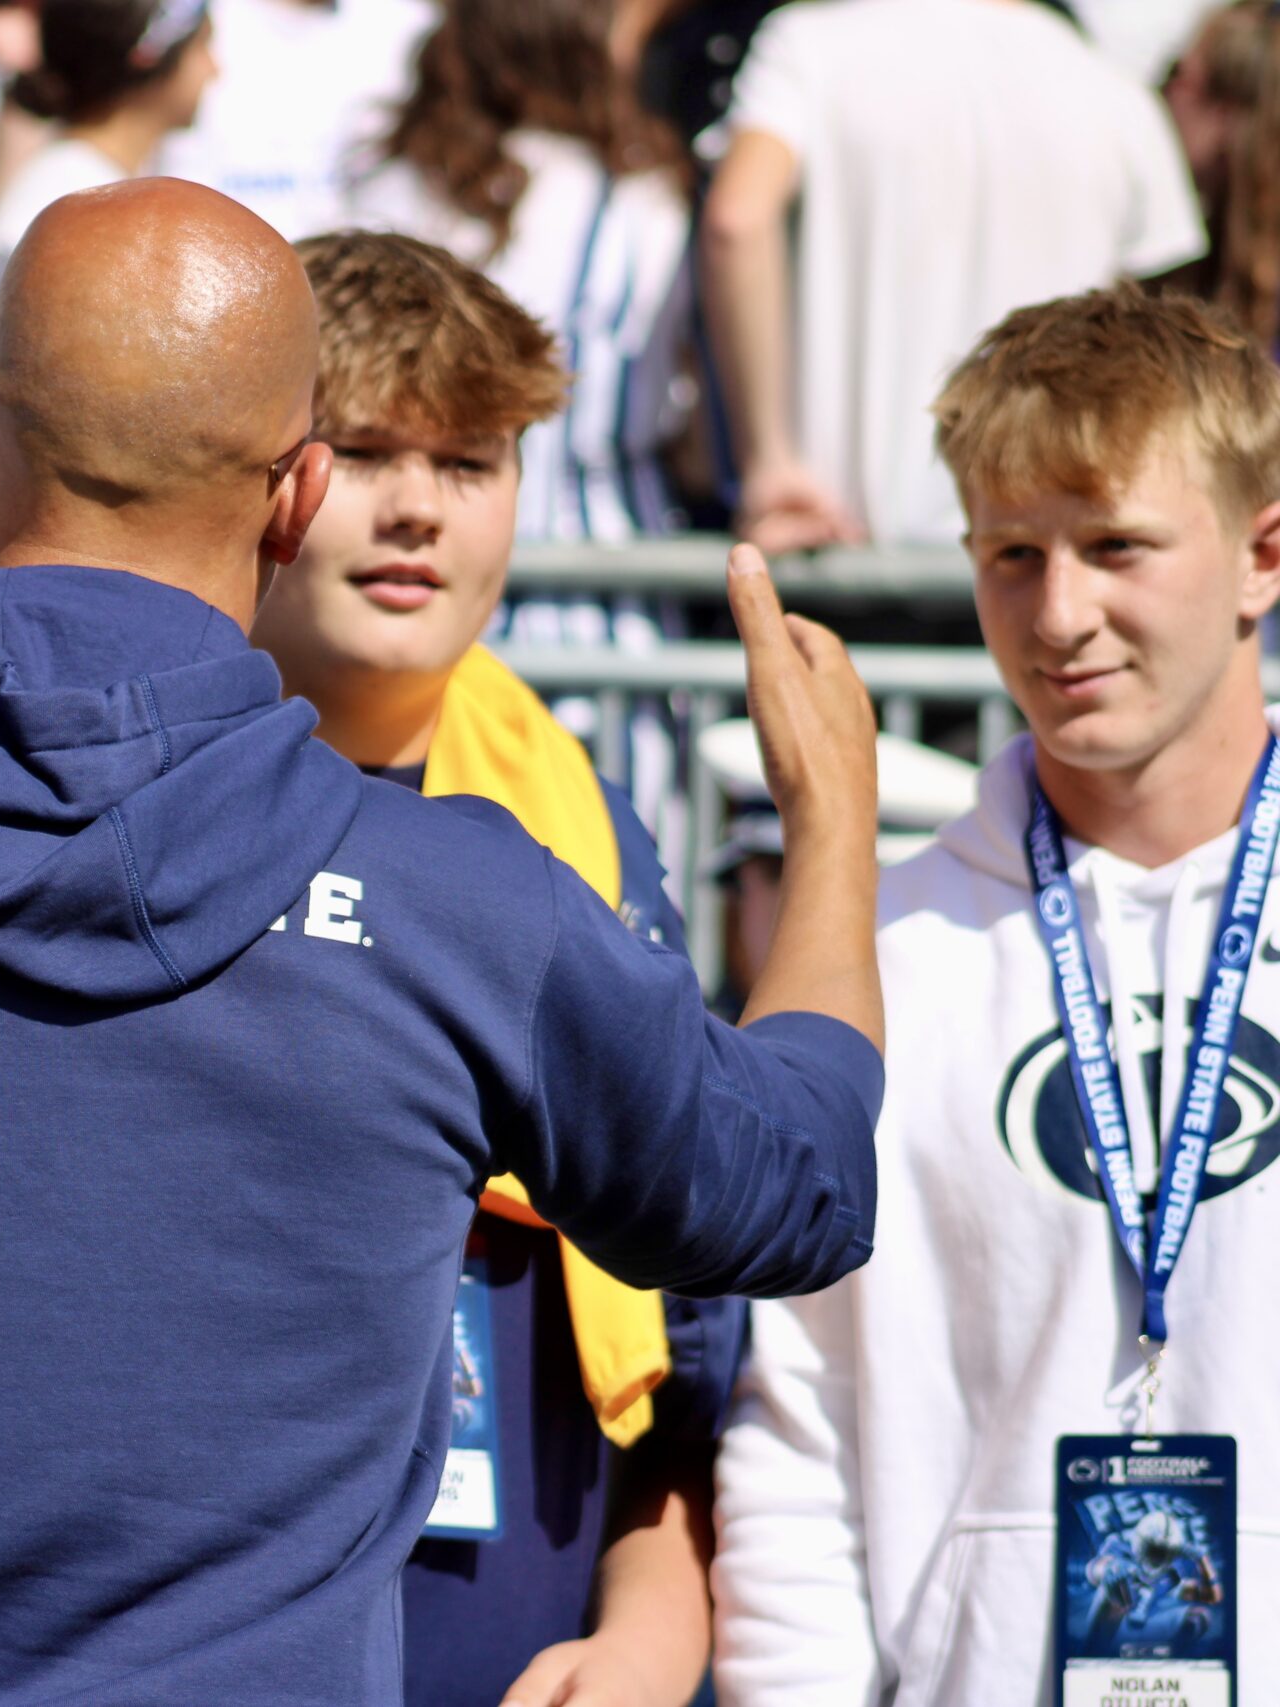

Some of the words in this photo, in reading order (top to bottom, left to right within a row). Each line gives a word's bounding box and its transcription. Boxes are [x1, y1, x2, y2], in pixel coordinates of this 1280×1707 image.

[1231, 787, 1280, 918] FOOTBALL
[1052, 927, 1105, 1061] FOOTBALL
[1202, 968, 1244, 1045] PENN
[1081, 1061, 1127, 1149] STATE
[1183, 1045, 1225, 1134] STATE
[1105, 1149, 1144, 1227] PENN
[1154, 1134, 1206, 1275] FOOTBALL
[1108, 1455, 1125, 1485] 1
[1111, 1677, 1180, 1692] NOLAN
